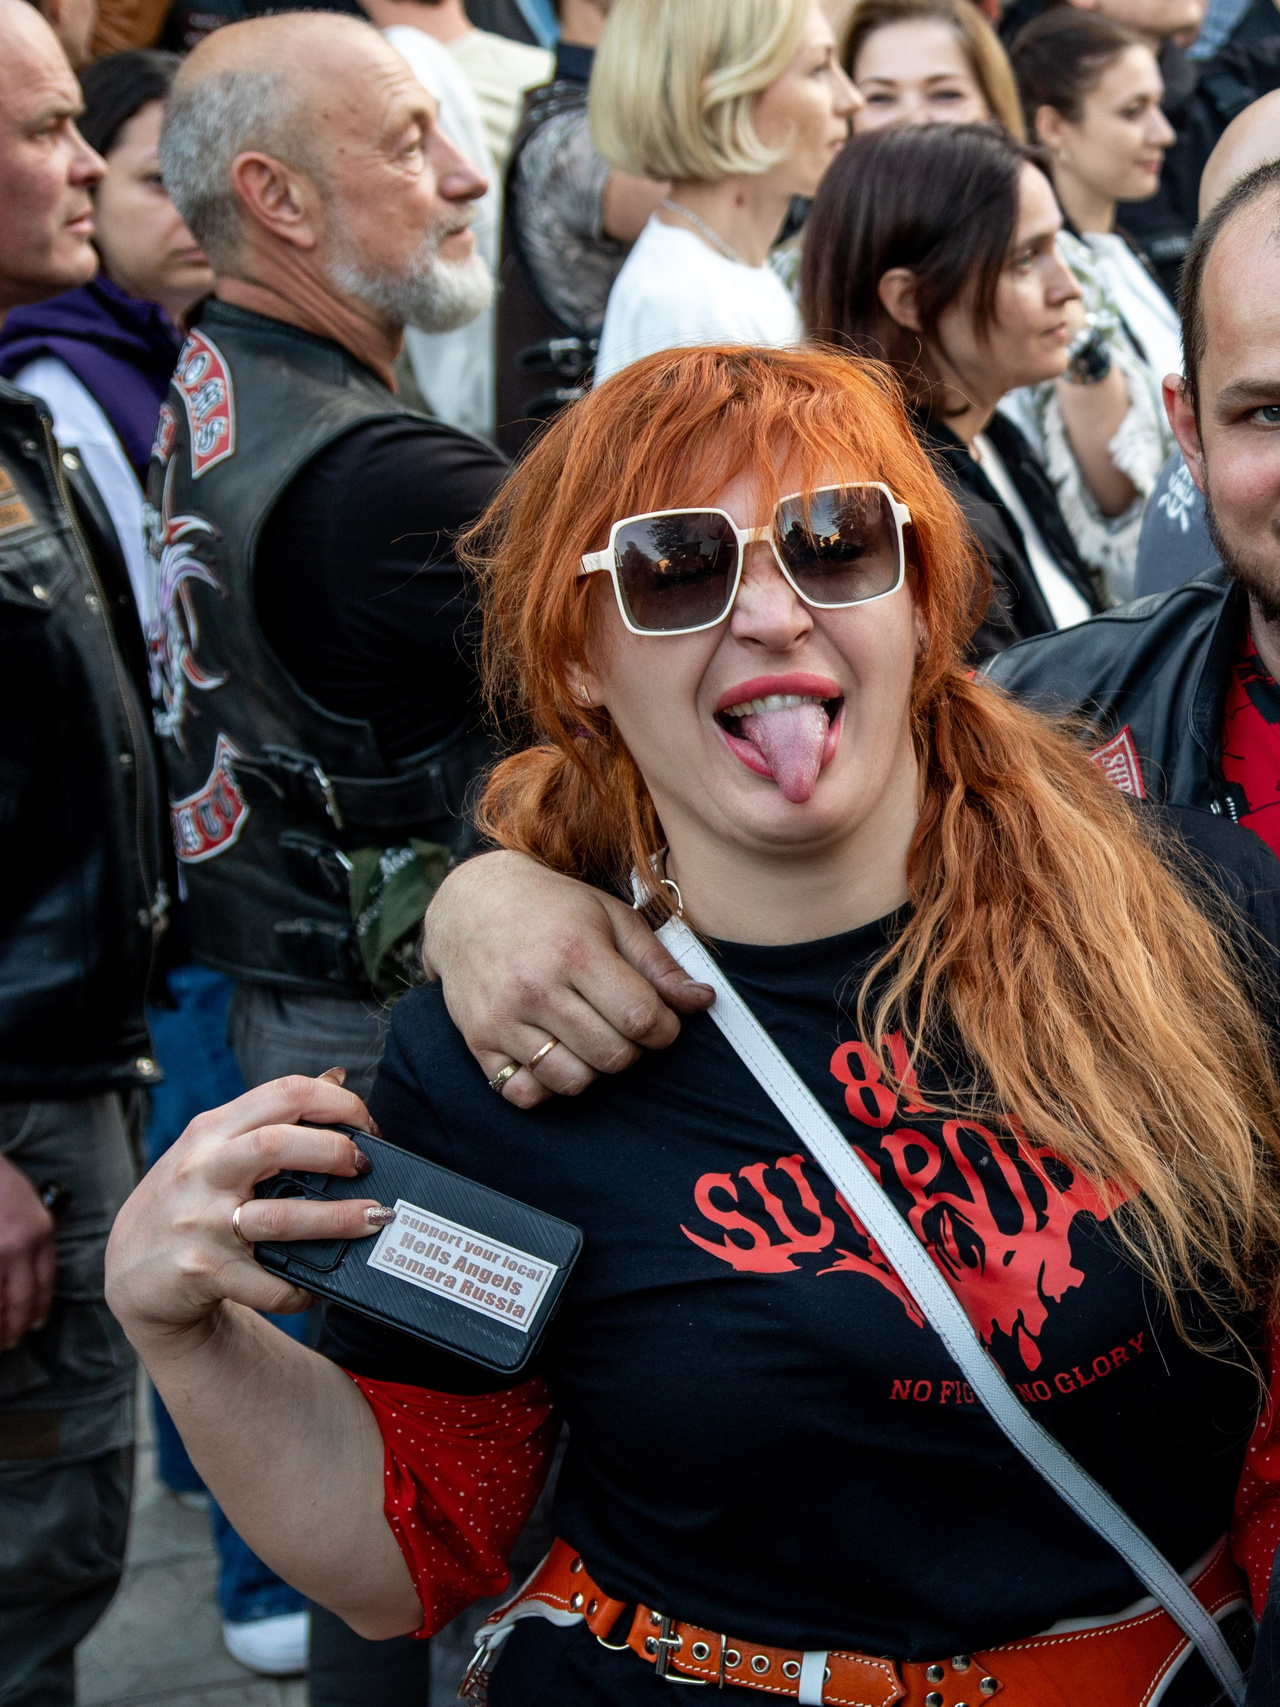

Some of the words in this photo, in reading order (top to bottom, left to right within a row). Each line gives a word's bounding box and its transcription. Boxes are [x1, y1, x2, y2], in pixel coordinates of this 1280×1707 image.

[830, 1029, 937, 1128] 81
[382, 1247, 457, 1289] Samara
[459, 1278, 526, 1319] Russia
[399, 1232, 451, 1265] Hells
[452, 1256, 523, 1296] Angels
[400, 1214, 463, 1248] support
[464, 1240, 501, 1264] your
[501, 1256, 543, 1283] local
[889, 1380, 932, 1402] NO
[939, 1380, 980, 1404] FIG
[1016, 1380, 1052, 1403] NO
[1054, 1331, 1144, 1394] GLORY
